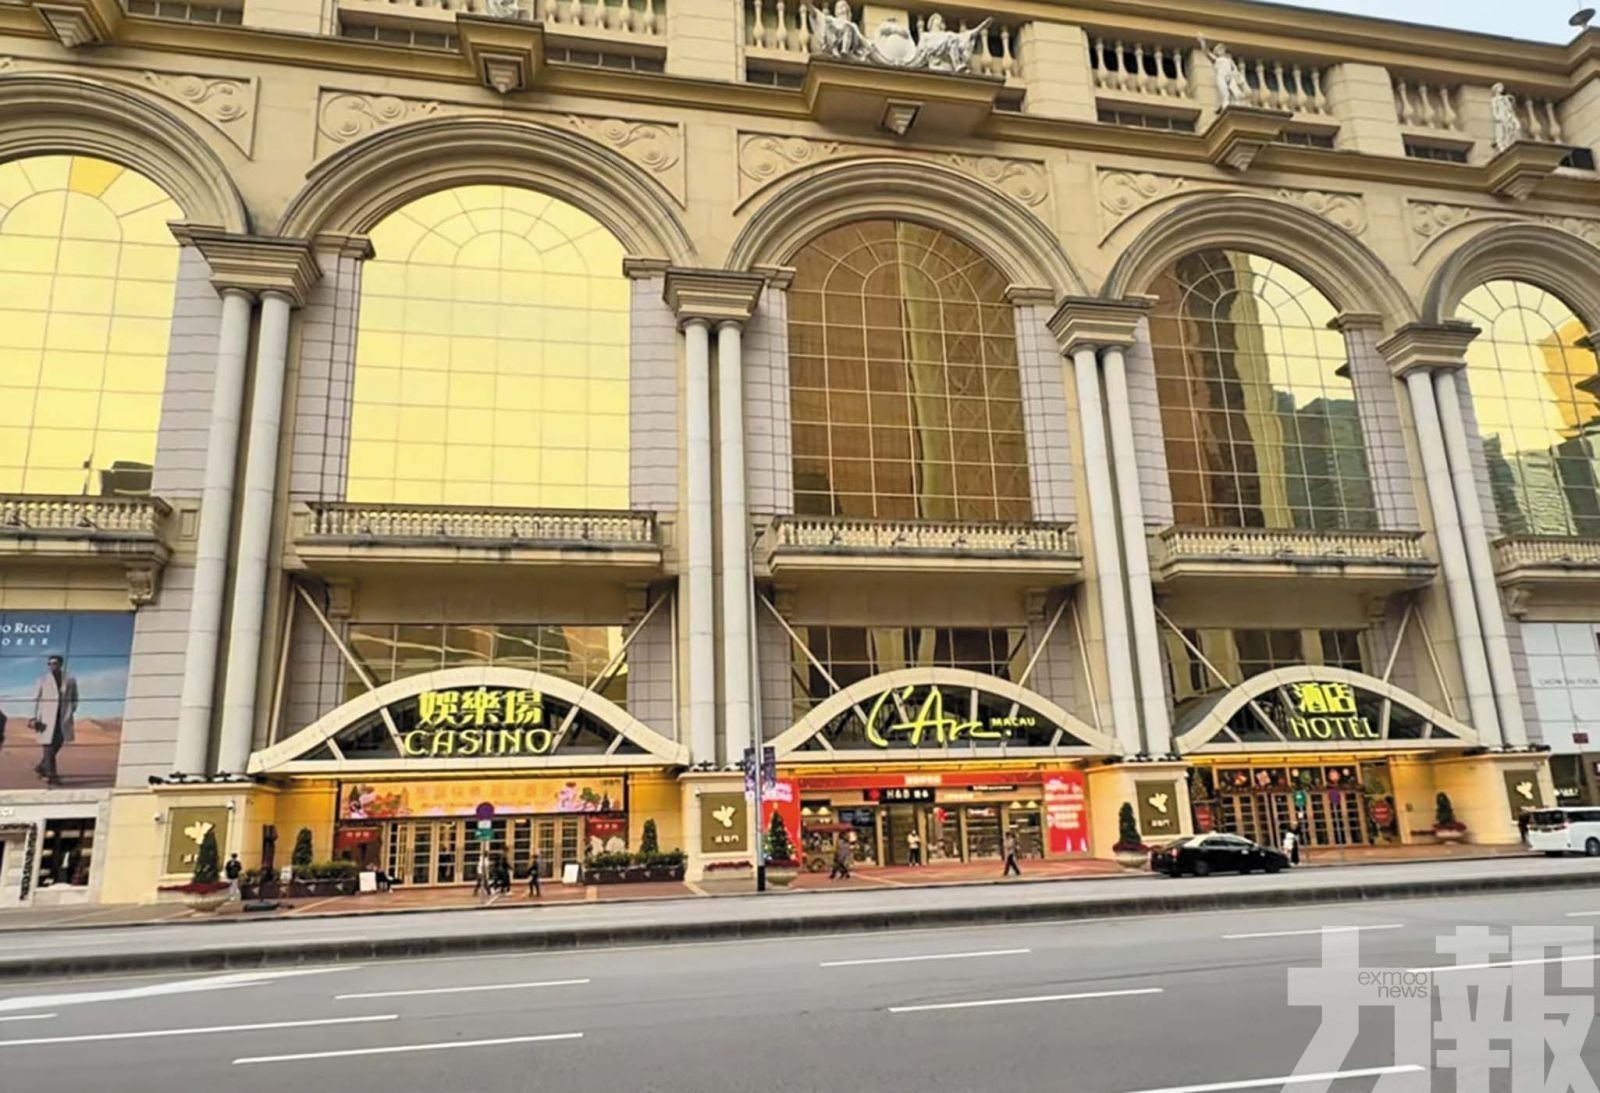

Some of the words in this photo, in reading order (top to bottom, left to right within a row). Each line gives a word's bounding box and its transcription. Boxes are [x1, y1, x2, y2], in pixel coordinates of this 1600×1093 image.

[15, 622, 51, 633] RICCI
[1292, 682, 1357, 712] 酒店
[991, 717, 1036, 727] MACAU
[1289, 716, 1379, 738] HOTEL
[404, 728, 552, 756] CASINO
